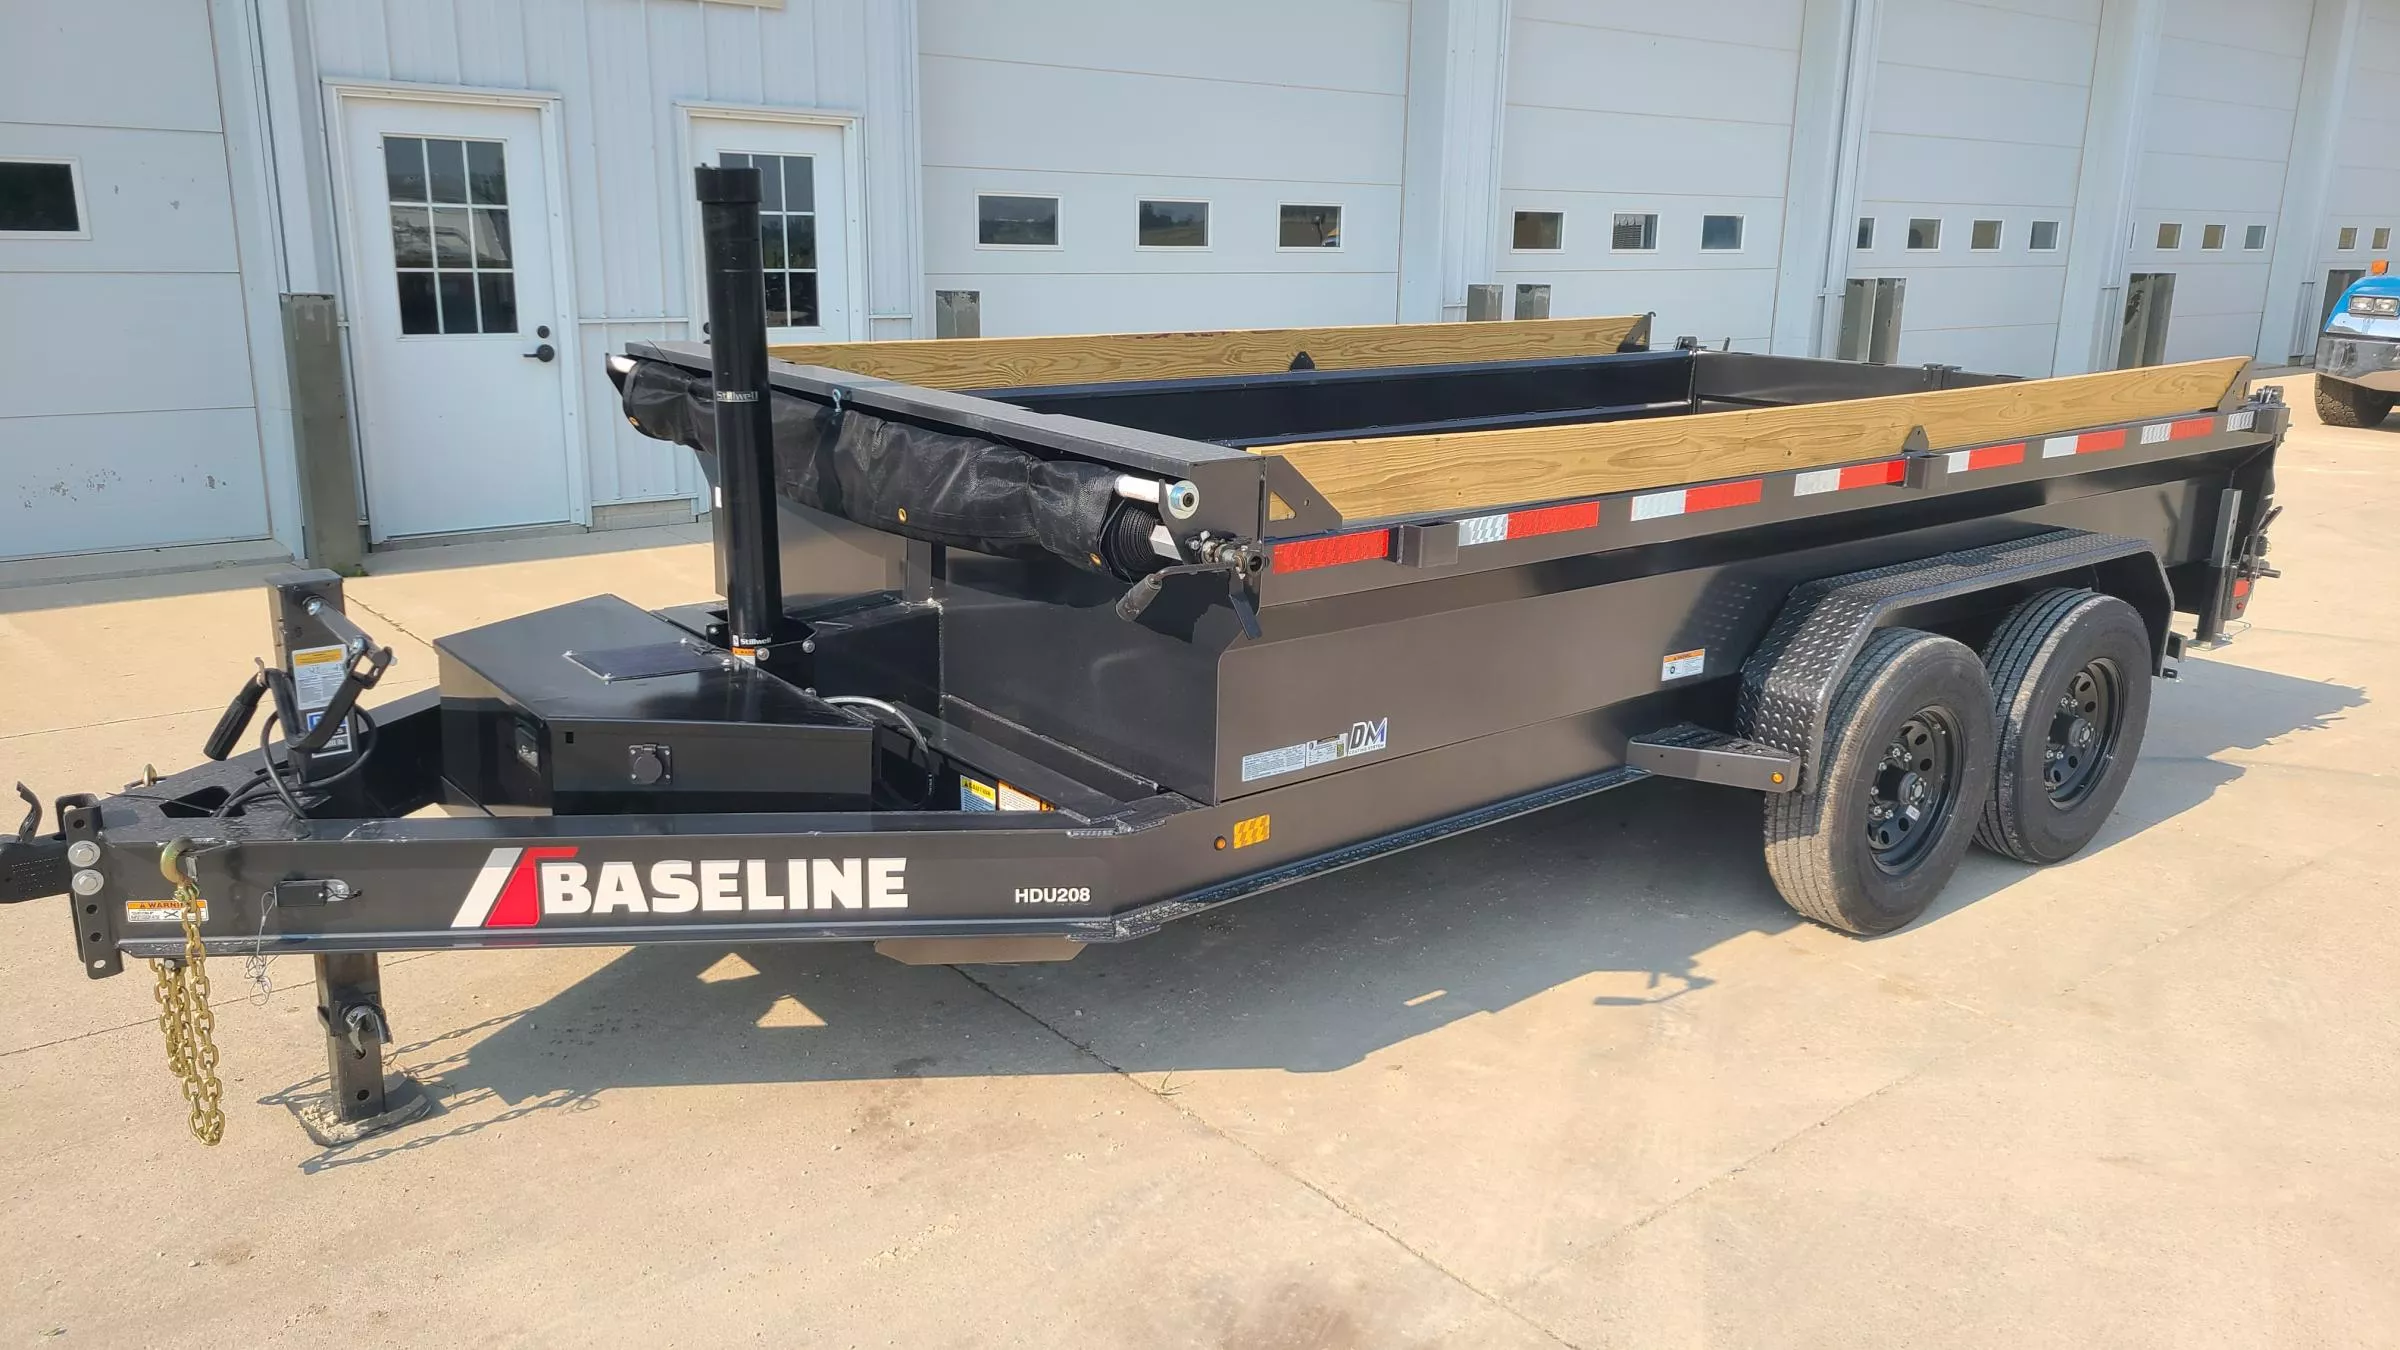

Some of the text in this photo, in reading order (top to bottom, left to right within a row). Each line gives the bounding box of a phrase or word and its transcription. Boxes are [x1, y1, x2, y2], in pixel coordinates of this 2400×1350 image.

[1350, 718, 1387, 749] DM
[541, 858, 909, 914] BASELINE
[1015, 887, 1091, 903] HDU208
